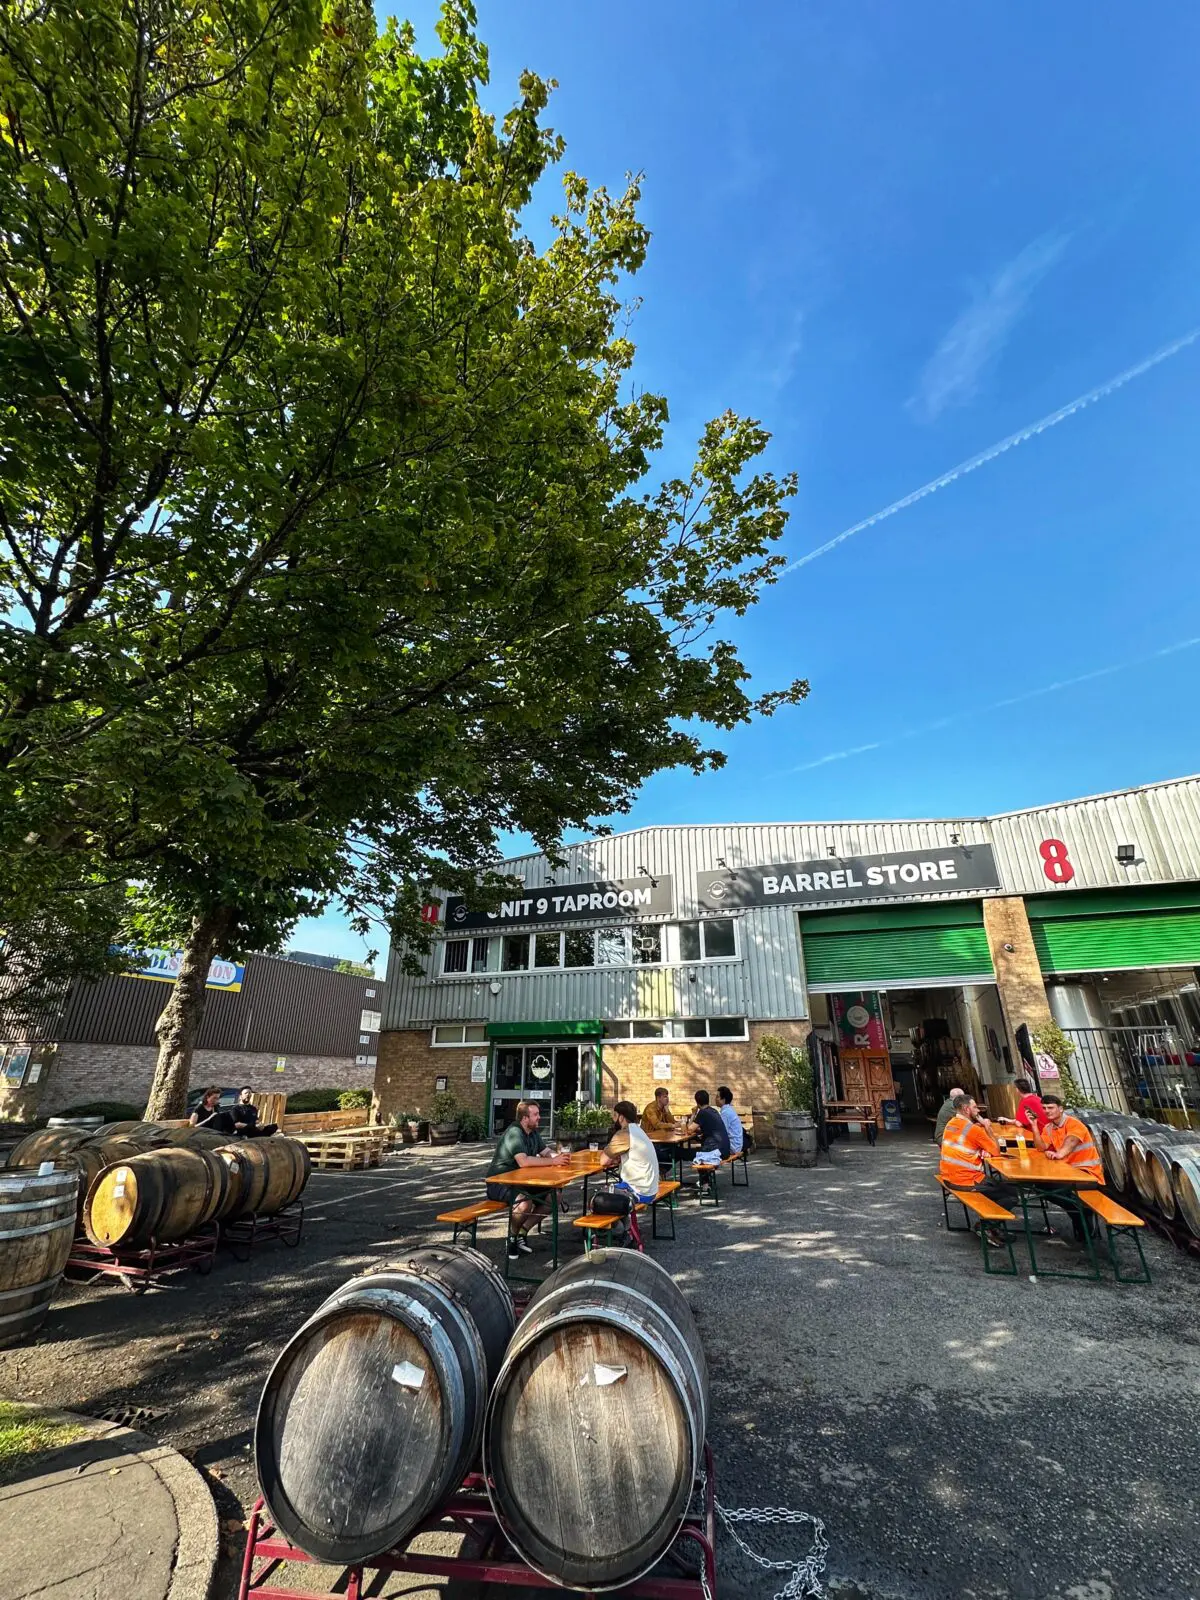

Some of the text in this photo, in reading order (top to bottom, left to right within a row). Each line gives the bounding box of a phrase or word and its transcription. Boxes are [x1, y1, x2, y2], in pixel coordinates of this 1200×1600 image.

[762, 859, 958, 895] BARREL STORE
[1039, 839, 1075, 883] 8
[536, 897, 549, 915] 9
[552, 887, 652, 912] TAPROOM
